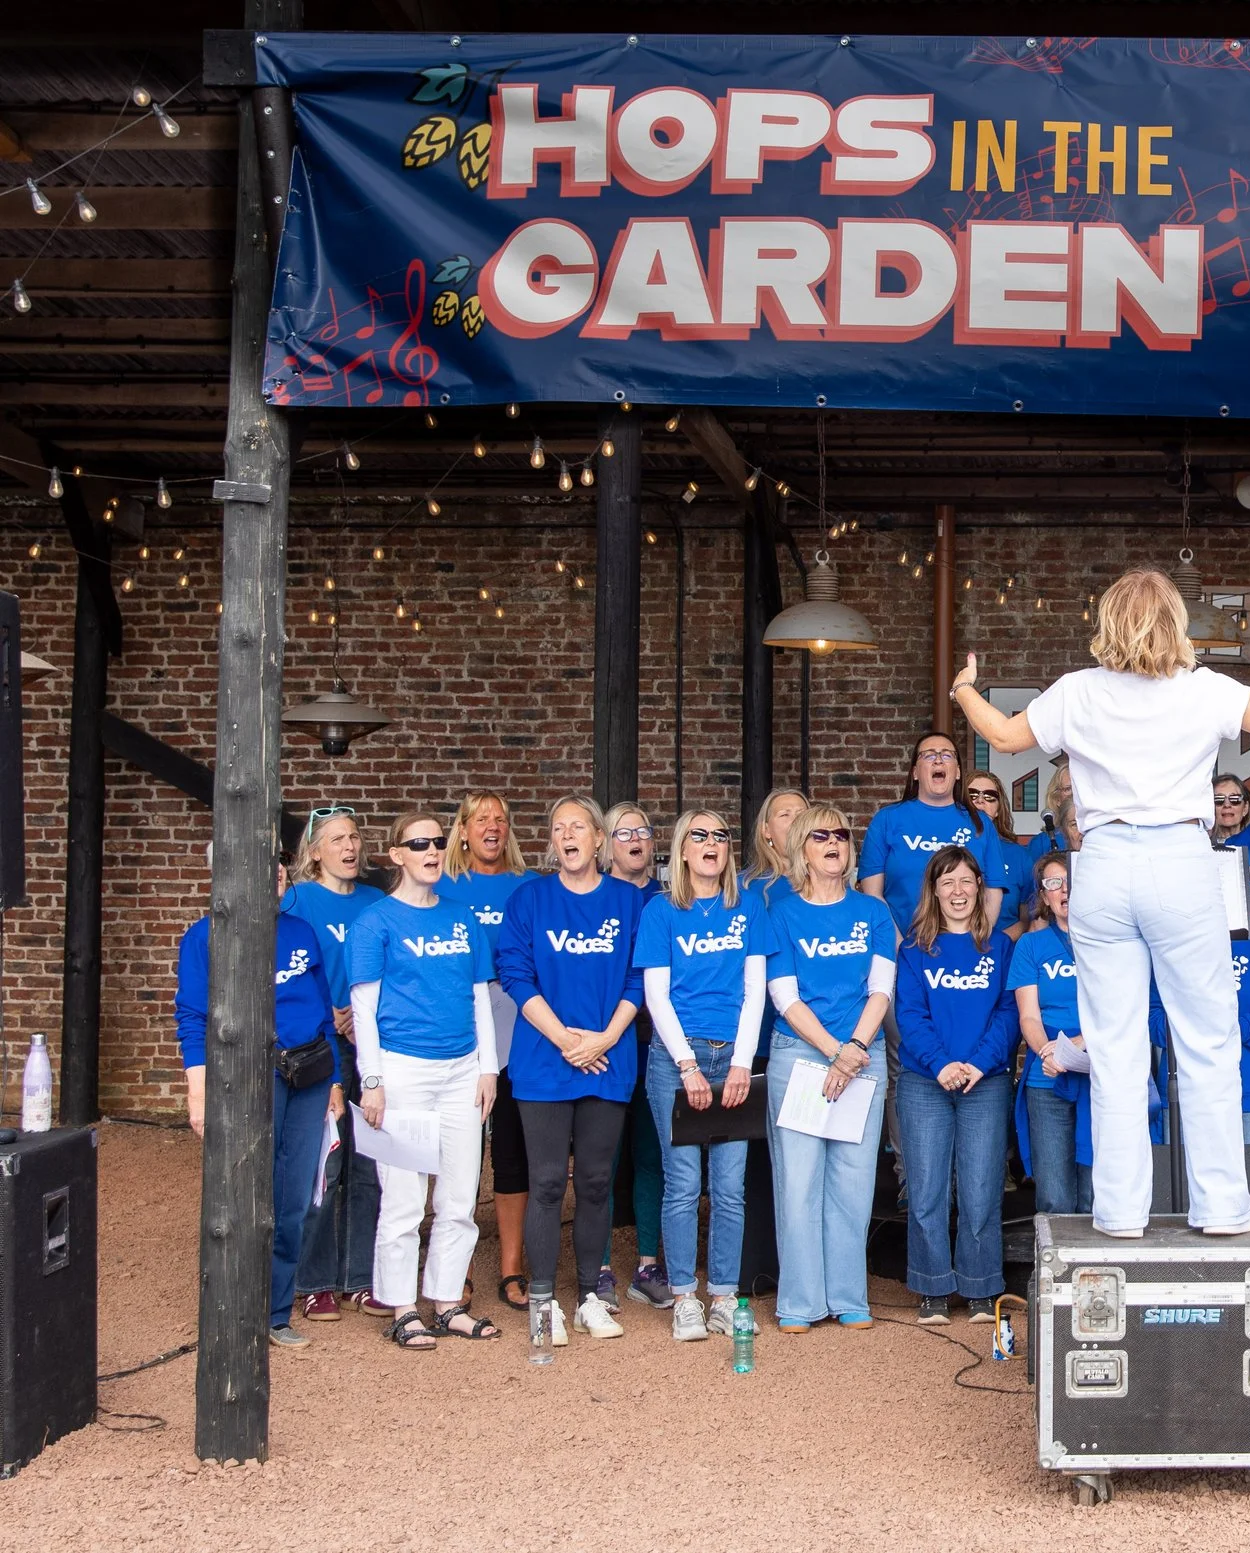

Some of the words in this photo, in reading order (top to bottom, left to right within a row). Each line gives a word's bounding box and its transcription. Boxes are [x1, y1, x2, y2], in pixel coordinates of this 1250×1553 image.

[488, 83, 935, 198] HOPS
[950, 120, 1017, 192] IN
[1043, 120, 1173, 196] THE
[478, 216, 1204, 351] GARDEN
[403, 935, 471, 959] Voices
[546, 930, 614, 954] Voices
[676, 931, 744, 956] Voices
[798, 936, 869, 959] Voices
[924, 968, 990, 990] Voices
[1144, 1308, 1221, 1324] SHURE
